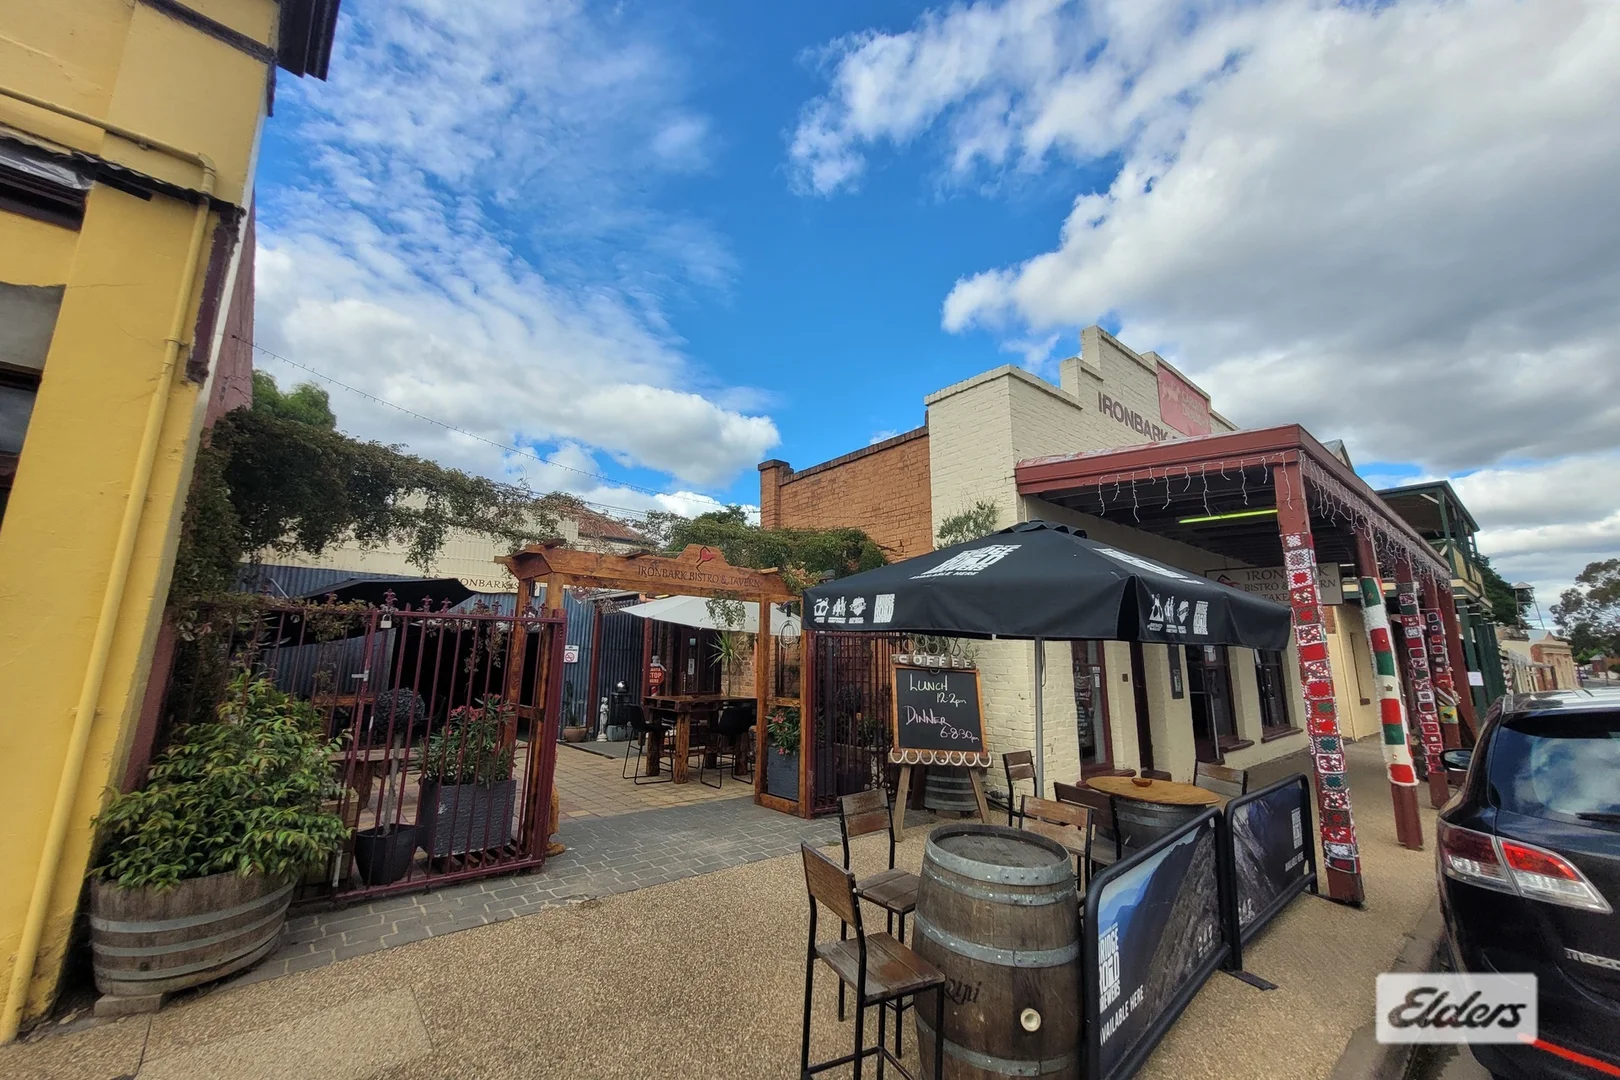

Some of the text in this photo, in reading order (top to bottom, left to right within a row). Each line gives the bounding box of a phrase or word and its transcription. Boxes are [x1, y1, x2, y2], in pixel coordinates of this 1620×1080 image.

[1097, 391, 1168, 441] IRONBARK
[638, 565, 760, 587] IRONBARK BISTRO & TAVERN
[1246, 565, 1329, 581] IRONK
[1244, 583, 1279, 592] BISTRO
[899, 655, 972, 668] COFFEE
[909, 673, 948, 692] LUNCH
[901, 705, 951, 727] DINNER
[1098, 927, 1119, 966] RIDGE
